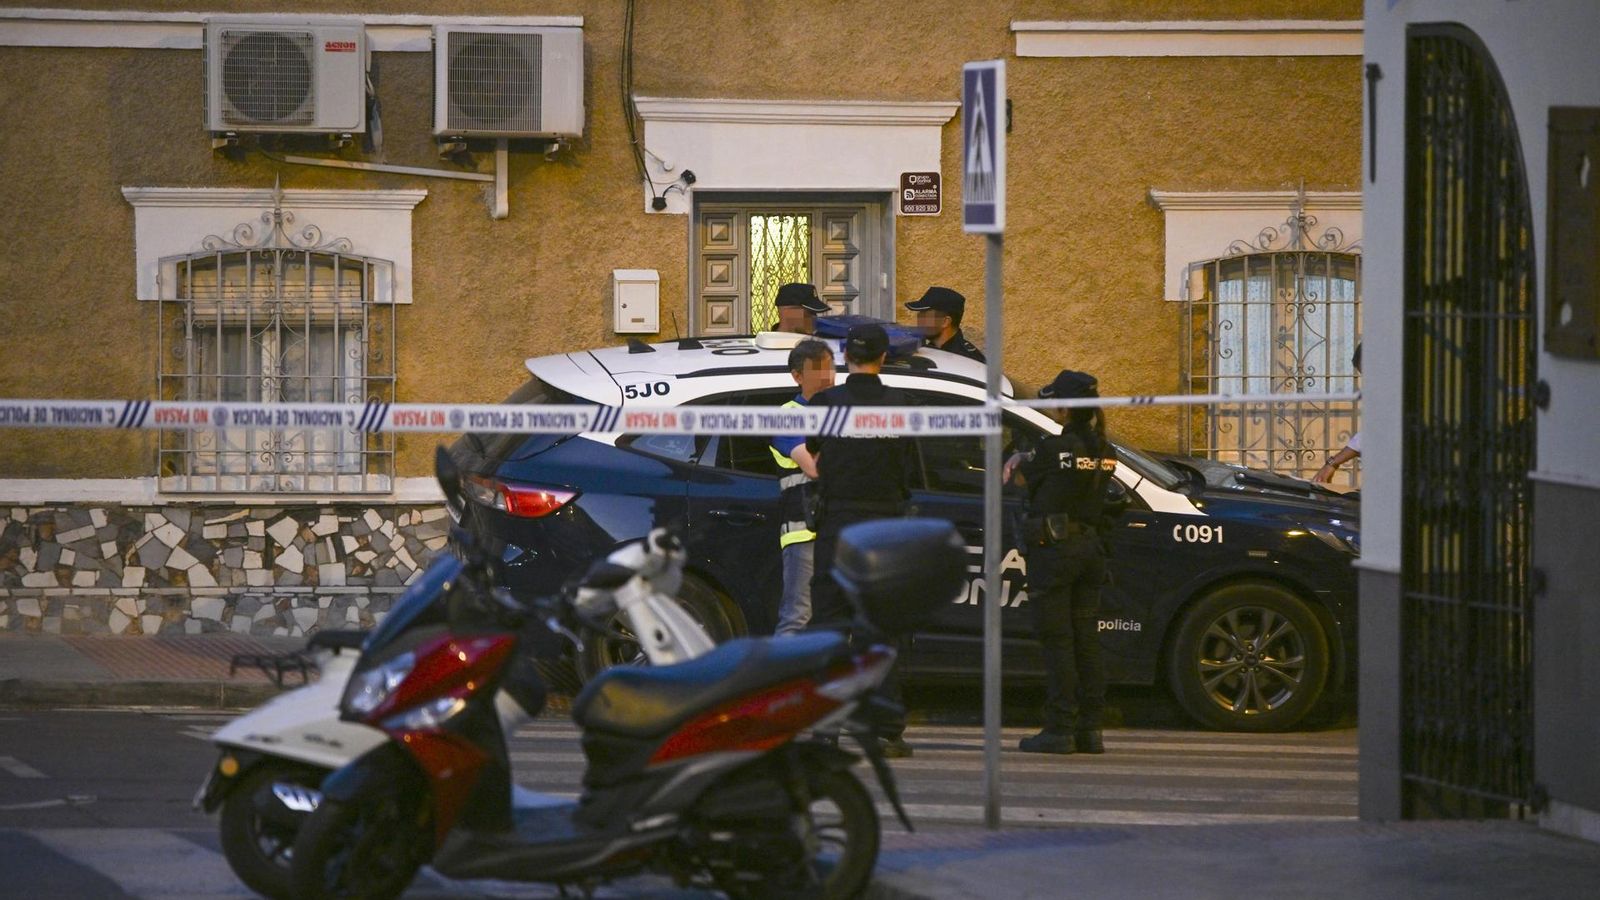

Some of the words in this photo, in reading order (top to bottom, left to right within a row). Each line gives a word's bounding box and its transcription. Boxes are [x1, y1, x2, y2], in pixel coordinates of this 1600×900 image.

[625, 381, 670, 400] 5JO
[0, 406, 31, 423] POLIC
[33, 406, 48, 423] DE
[51, 407, 103, 423] NACIONAL
[154, 408, 190, 423] PASAR
[193, 408, 208, 423] NO
[232, 409, 273, 424] POLICIA
[276, 409, 289, 425] DE
[294, 410, 342, 425] NACIONAL
[392, 411, 427, 426] PASAR
[430, 411, 445, 426] NO
[469, 412, 508, 426] POLICIA
[511, 412, 524, 426] DE
[528, 412, 576, 426] NACIONAL
[626, 412, 660, 427] PASAR
[662, 412, 677, 427] NO
[700, 413, 739, 428] POLICIA
[742, 413, 754, 428] DE
[758, 413, 805, 428] NACIONAL
[855, 413, 888, 428] PASAR
[891, 413, 905, 428] NO
[928, 413, 967, 428] POLICIA
[1097, 619, 1141, 632] policia
